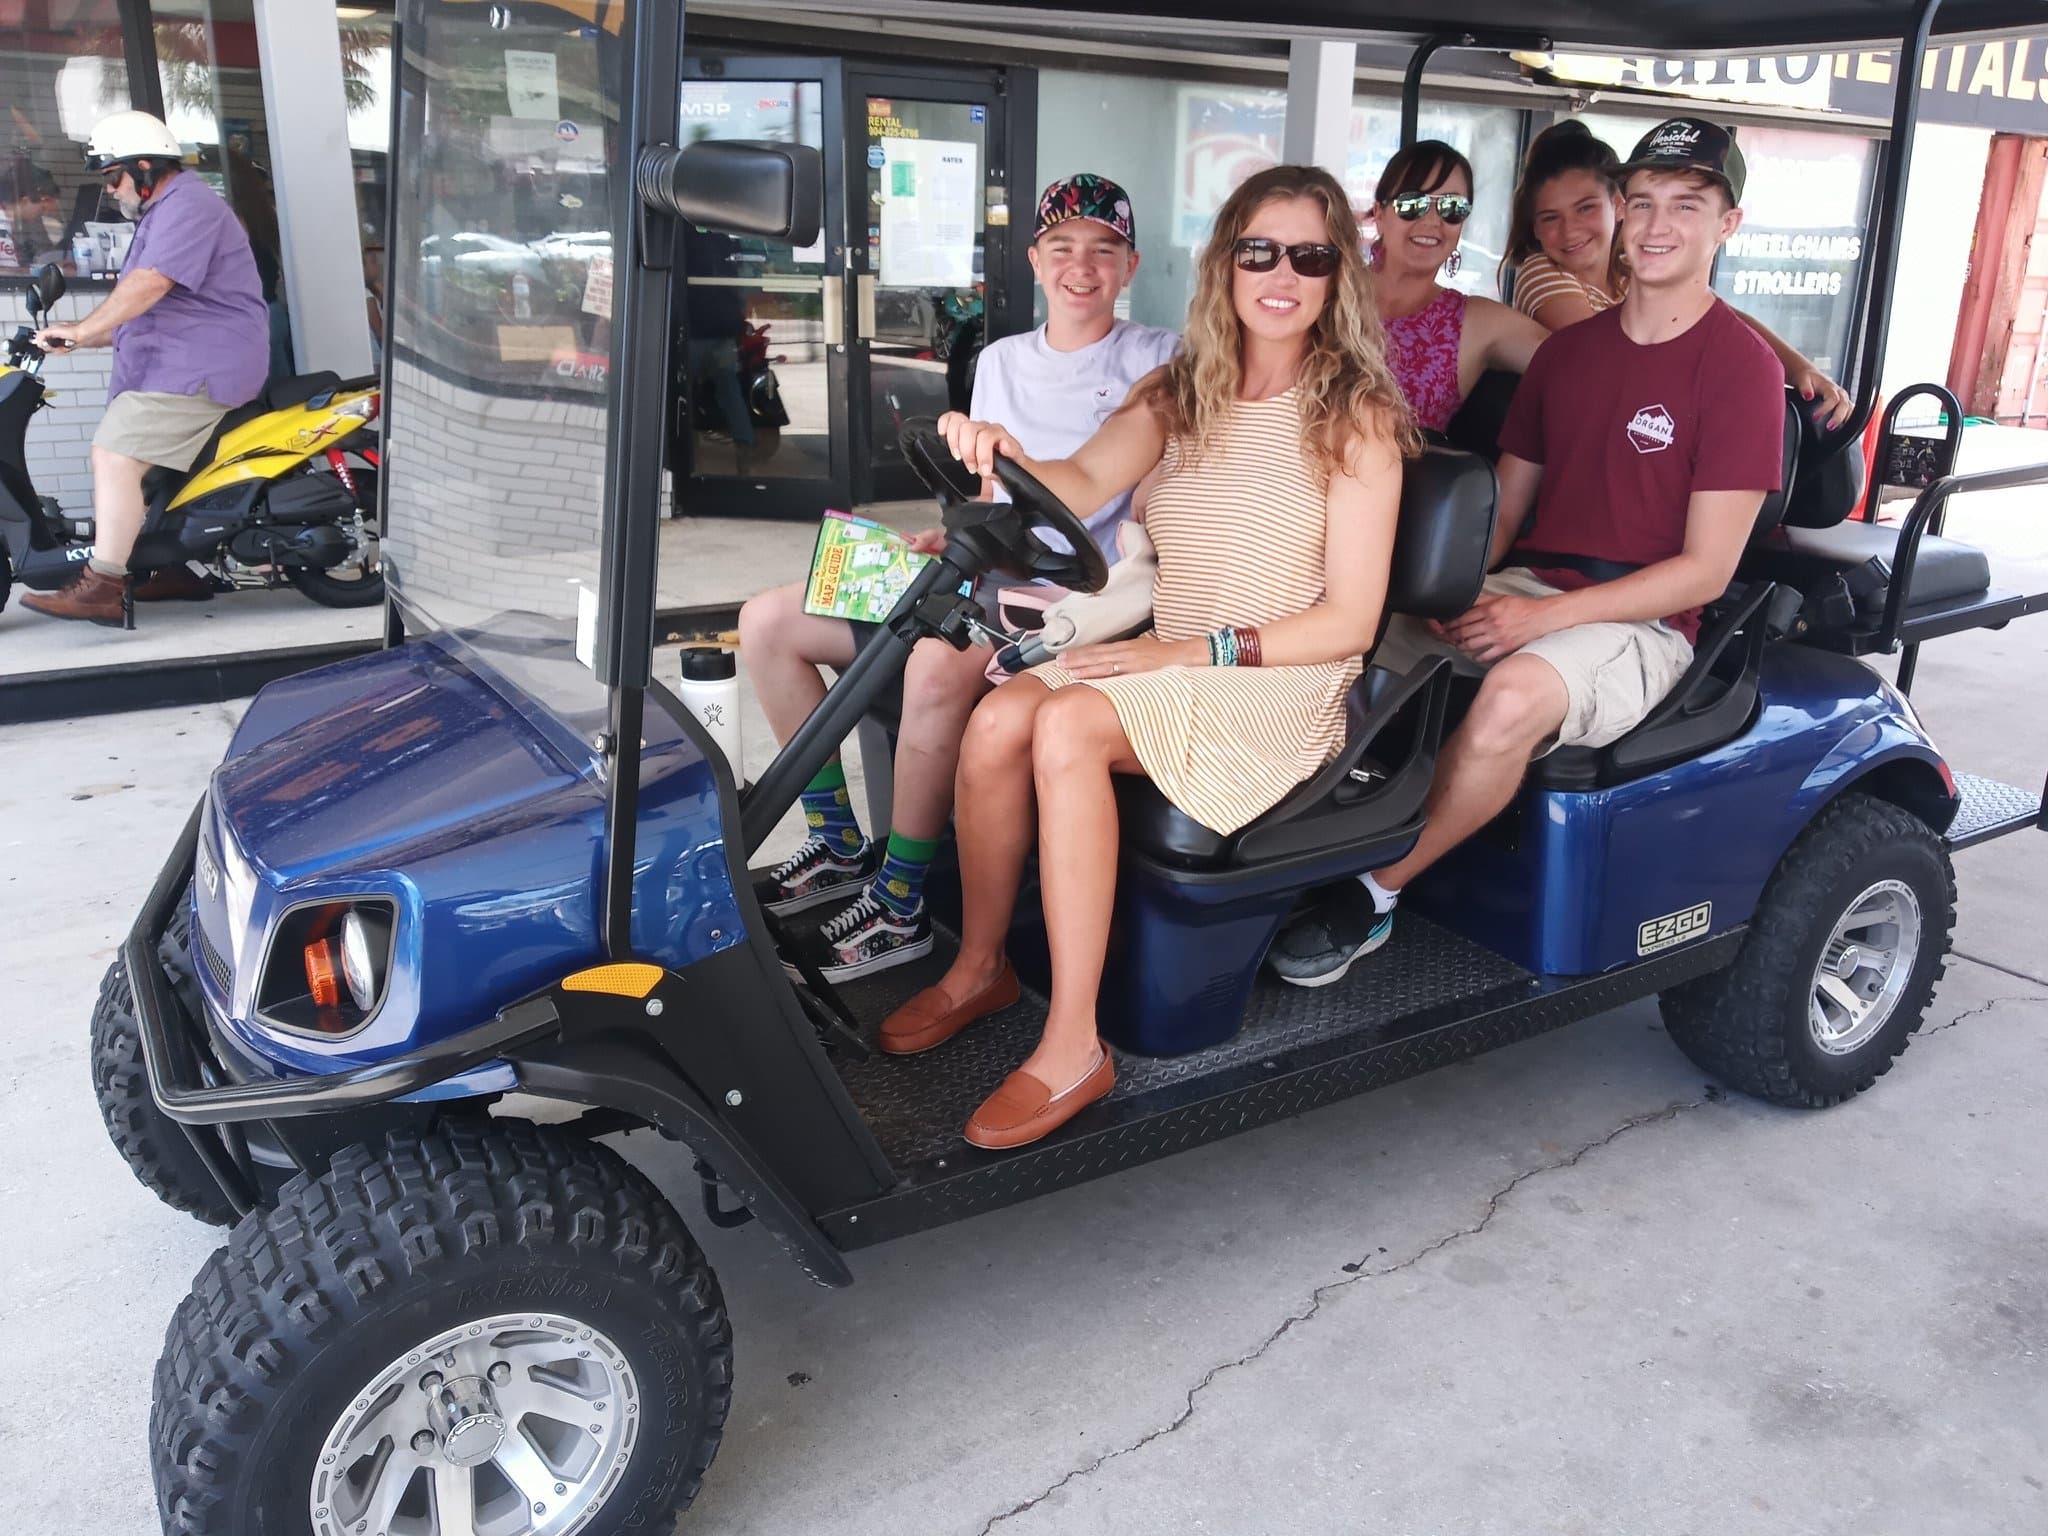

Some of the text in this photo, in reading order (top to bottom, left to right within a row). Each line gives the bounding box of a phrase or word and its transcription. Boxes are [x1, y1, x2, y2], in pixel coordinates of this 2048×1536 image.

[868, 116, 902, 128] RENTAL
[1649, 128, 1701, 148] Herschel
[1726, 232, 1861, 261] WHEELCHAIRS
[1733, 270, 1842, 295] STROLLERS
[1635, 417, 1669, 435] ORGAN
[821, 585, 835, 606] MAP
[829, 547, 843, 575] GUIDE
[1641, 905, 1708, 946] EZGO
[456, 1273, 612, 1311] KENDA
[642, 1320, 689, 1437] TERRA
